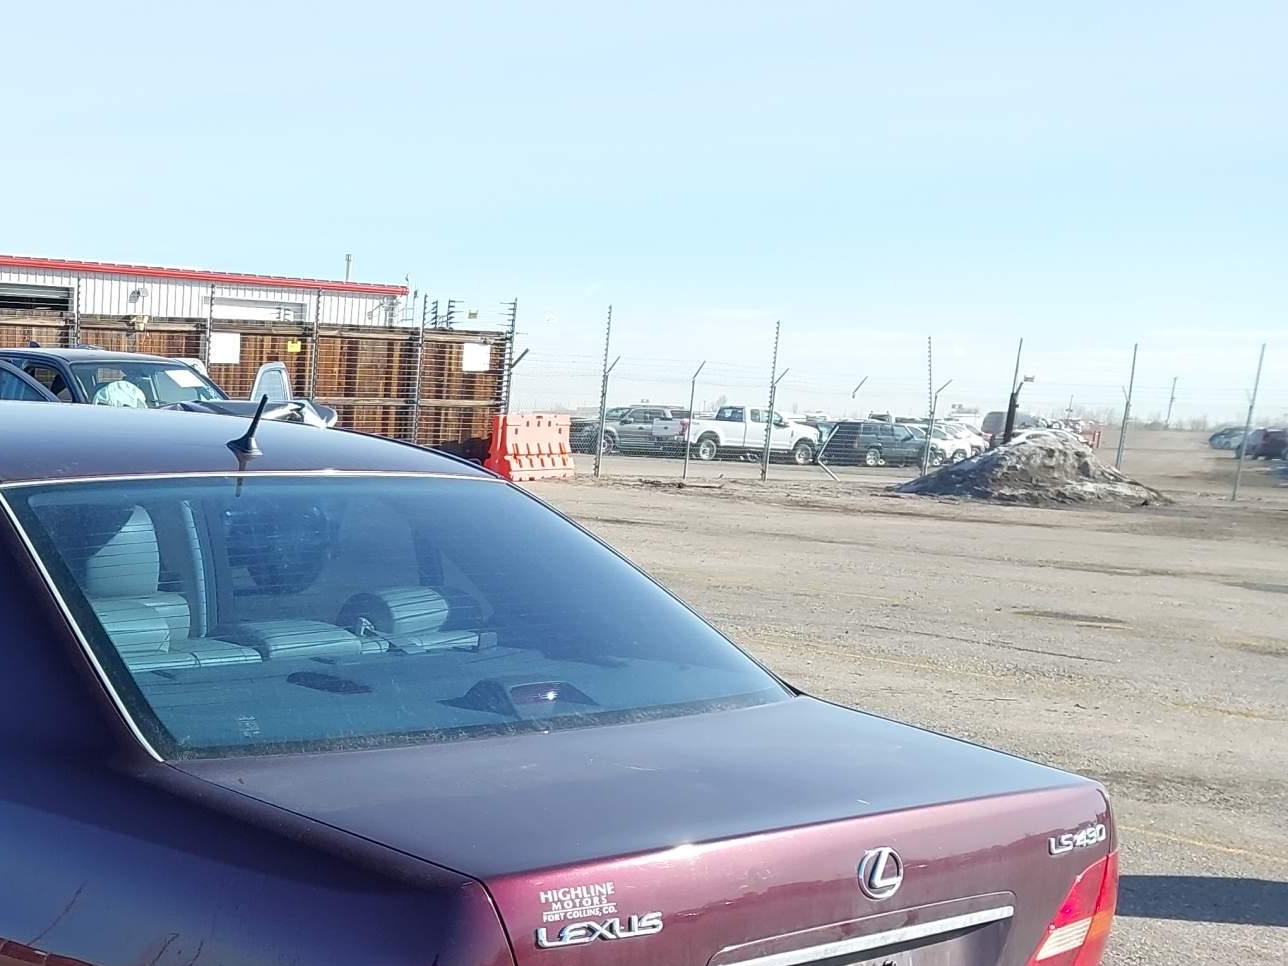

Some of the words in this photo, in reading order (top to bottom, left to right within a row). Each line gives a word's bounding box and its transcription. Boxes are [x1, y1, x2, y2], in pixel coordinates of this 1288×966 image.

[539, 882, 616, 903] HIGHLINE
[551, 896, 608, 911] MOTORS
[543, 911, 567, 922] FORT
[536, 911, 664, 948] LEXUS
